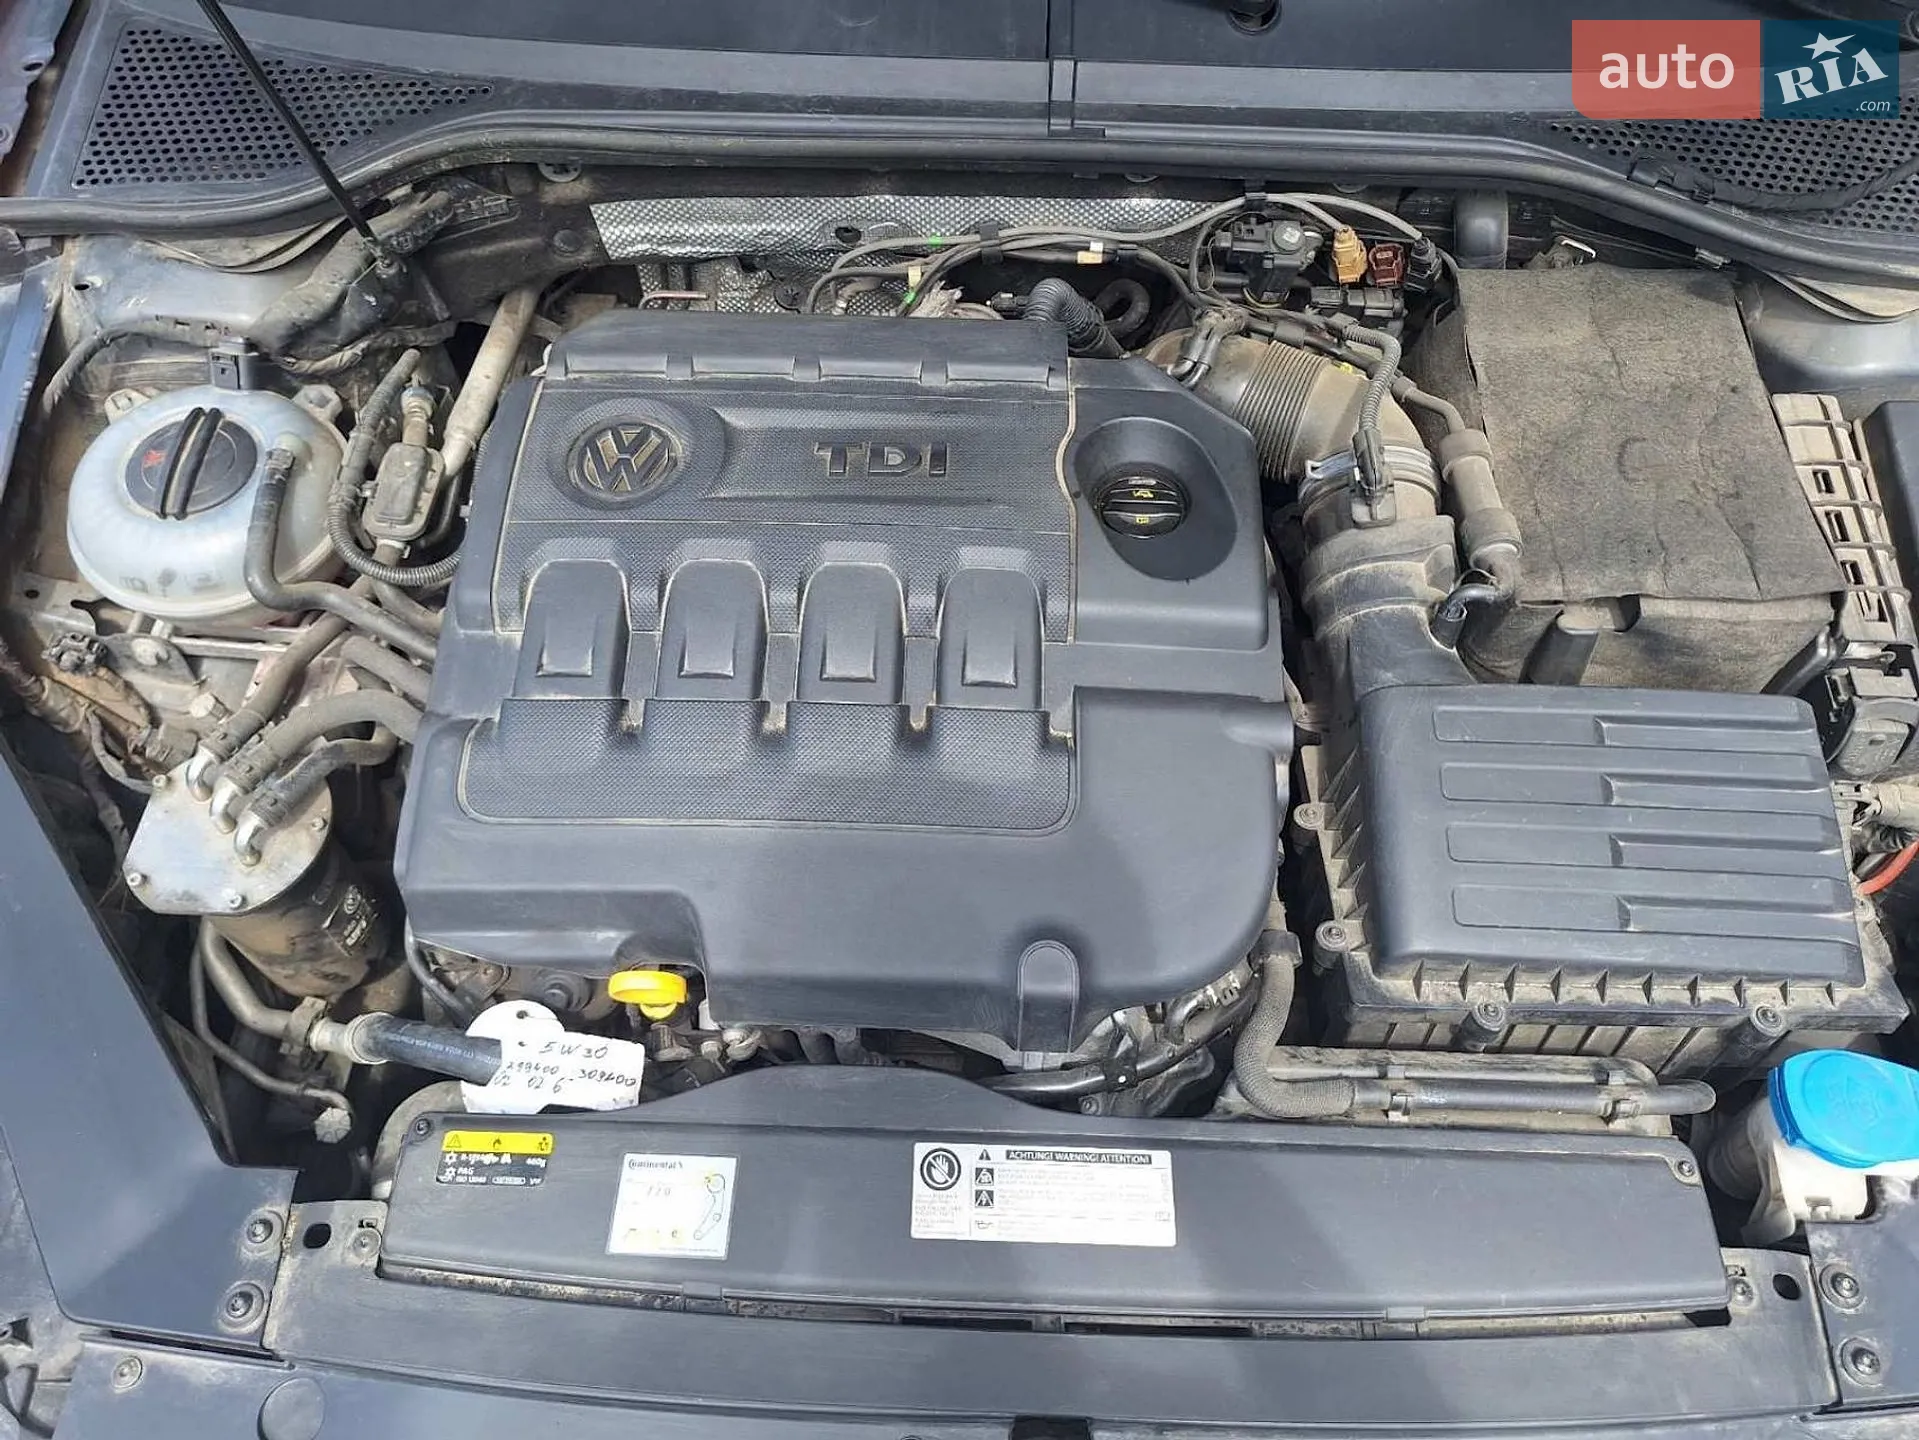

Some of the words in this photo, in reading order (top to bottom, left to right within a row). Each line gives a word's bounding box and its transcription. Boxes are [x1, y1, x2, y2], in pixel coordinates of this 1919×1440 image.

[815, 441, 949, 477] TDI
[1009, 1150, 1053, 1161] ACHTUNG!
[1054, 1152, 1100, 1163] WARNING!
